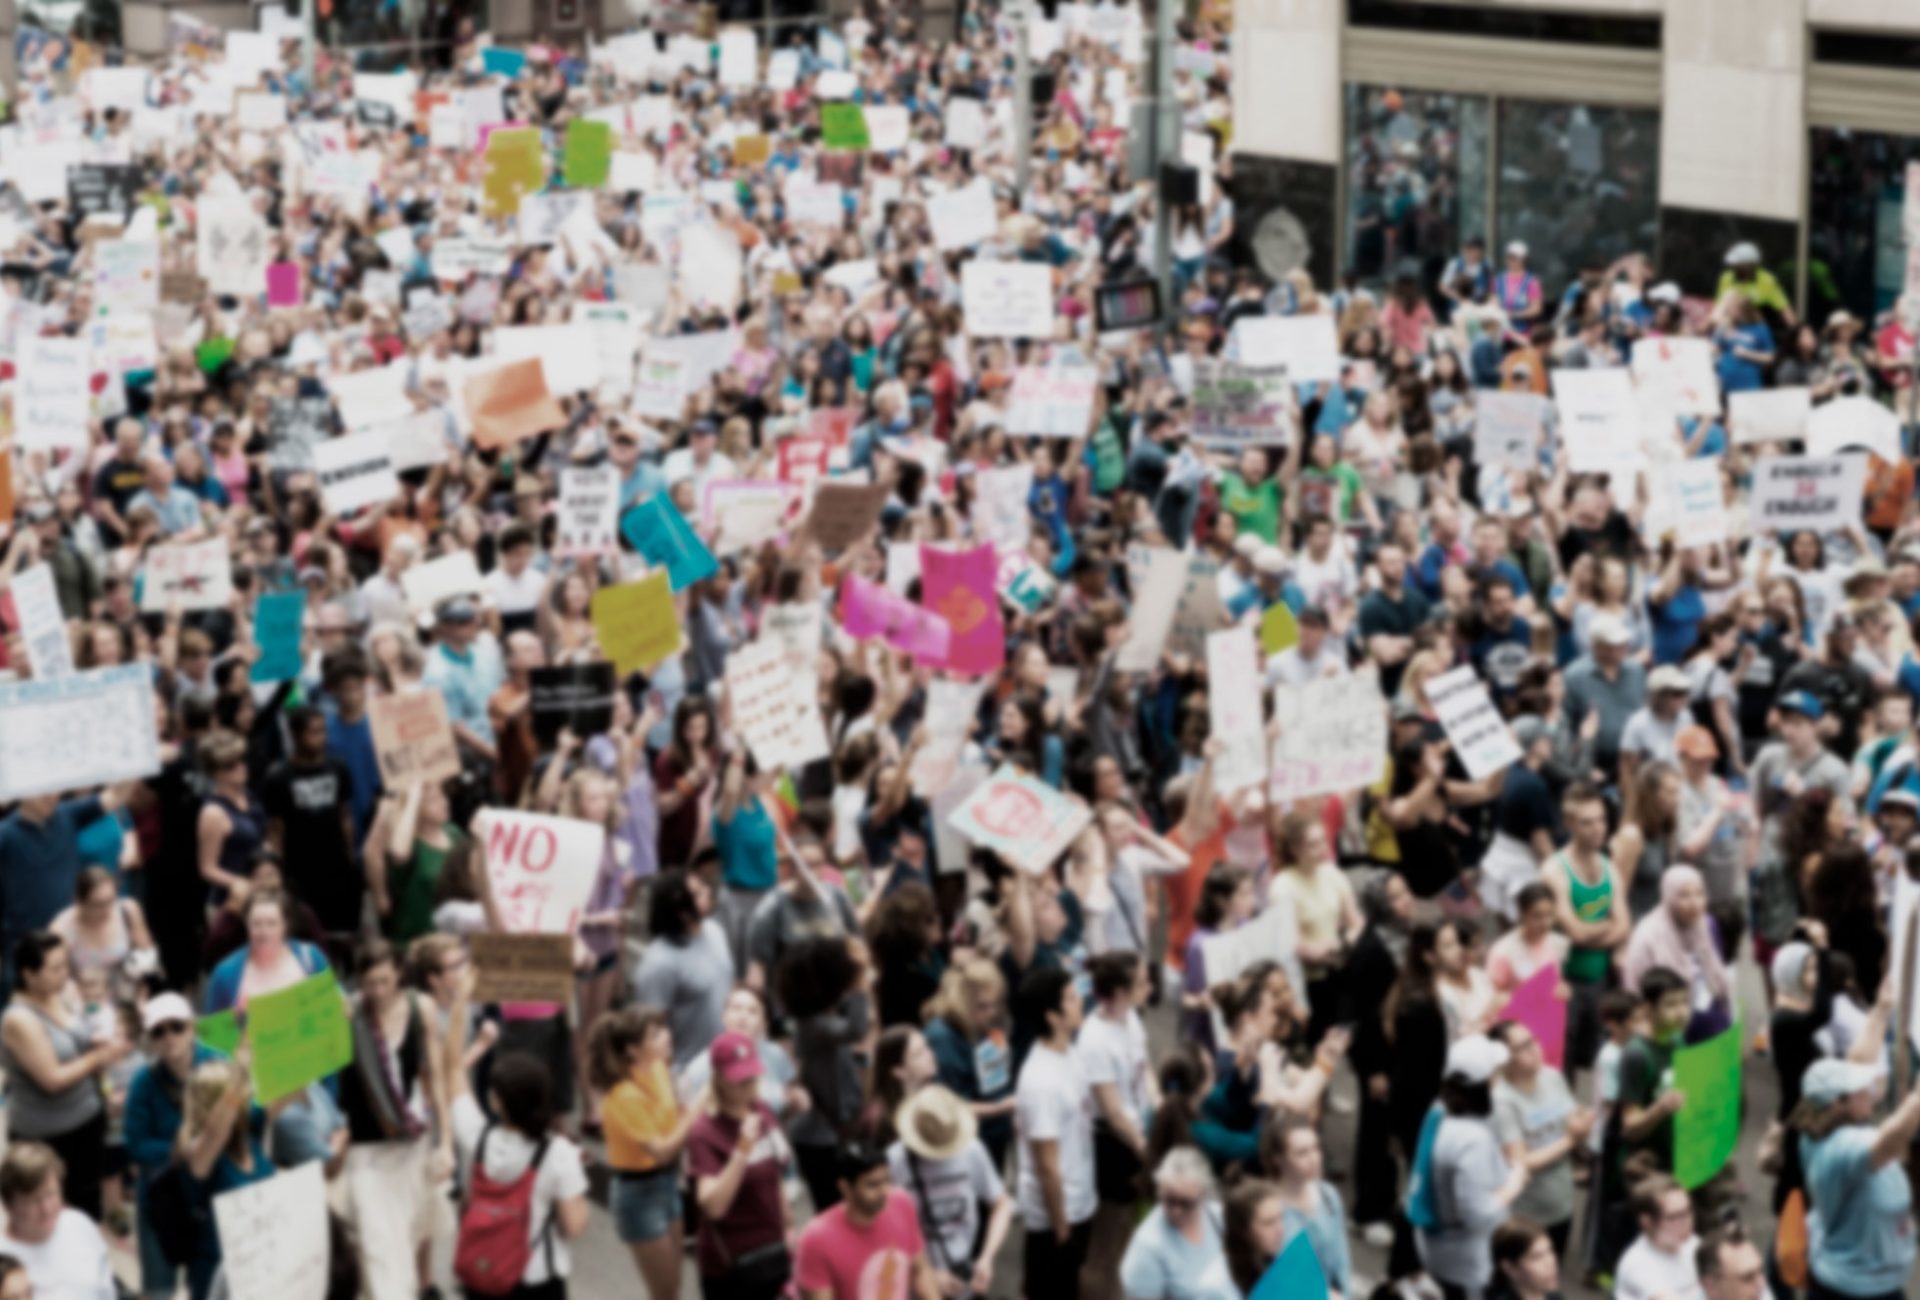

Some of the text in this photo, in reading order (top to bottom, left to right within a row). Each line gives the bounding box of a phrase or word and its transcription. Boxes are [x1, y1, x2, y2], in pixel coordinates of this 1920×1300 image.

[1770, 462, 1842, 480] ENOUGH
[1764, 497, 1838, 516] ENOUGH
[488, 821, 559, 873] NO
